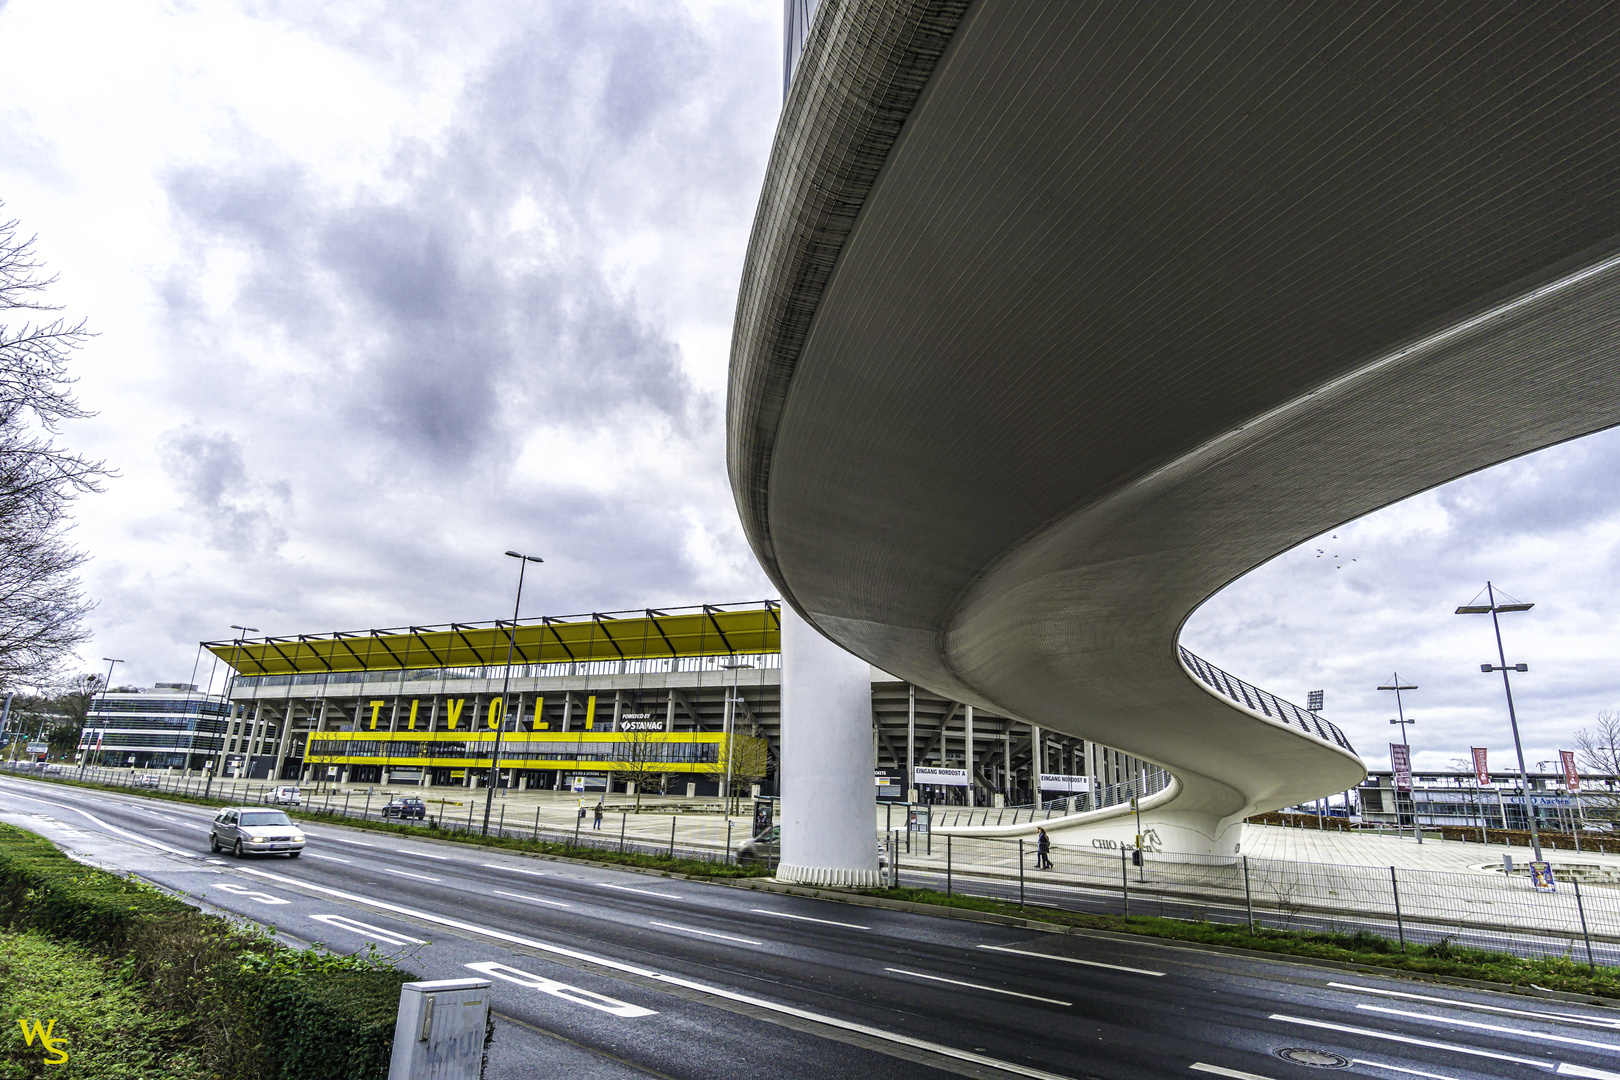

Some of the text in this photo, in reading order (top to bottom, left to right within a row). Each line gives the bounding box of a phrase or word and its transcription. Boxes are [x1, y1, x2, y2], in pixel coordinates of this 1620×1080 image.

[369, 695, 597, 730] TIVOLI
[630, 721, 663, 730] STAWAG
[1510, 796, 1570, 805] CHO Aachen
[1091, 838, 1153, 853] CHIO Aacen
